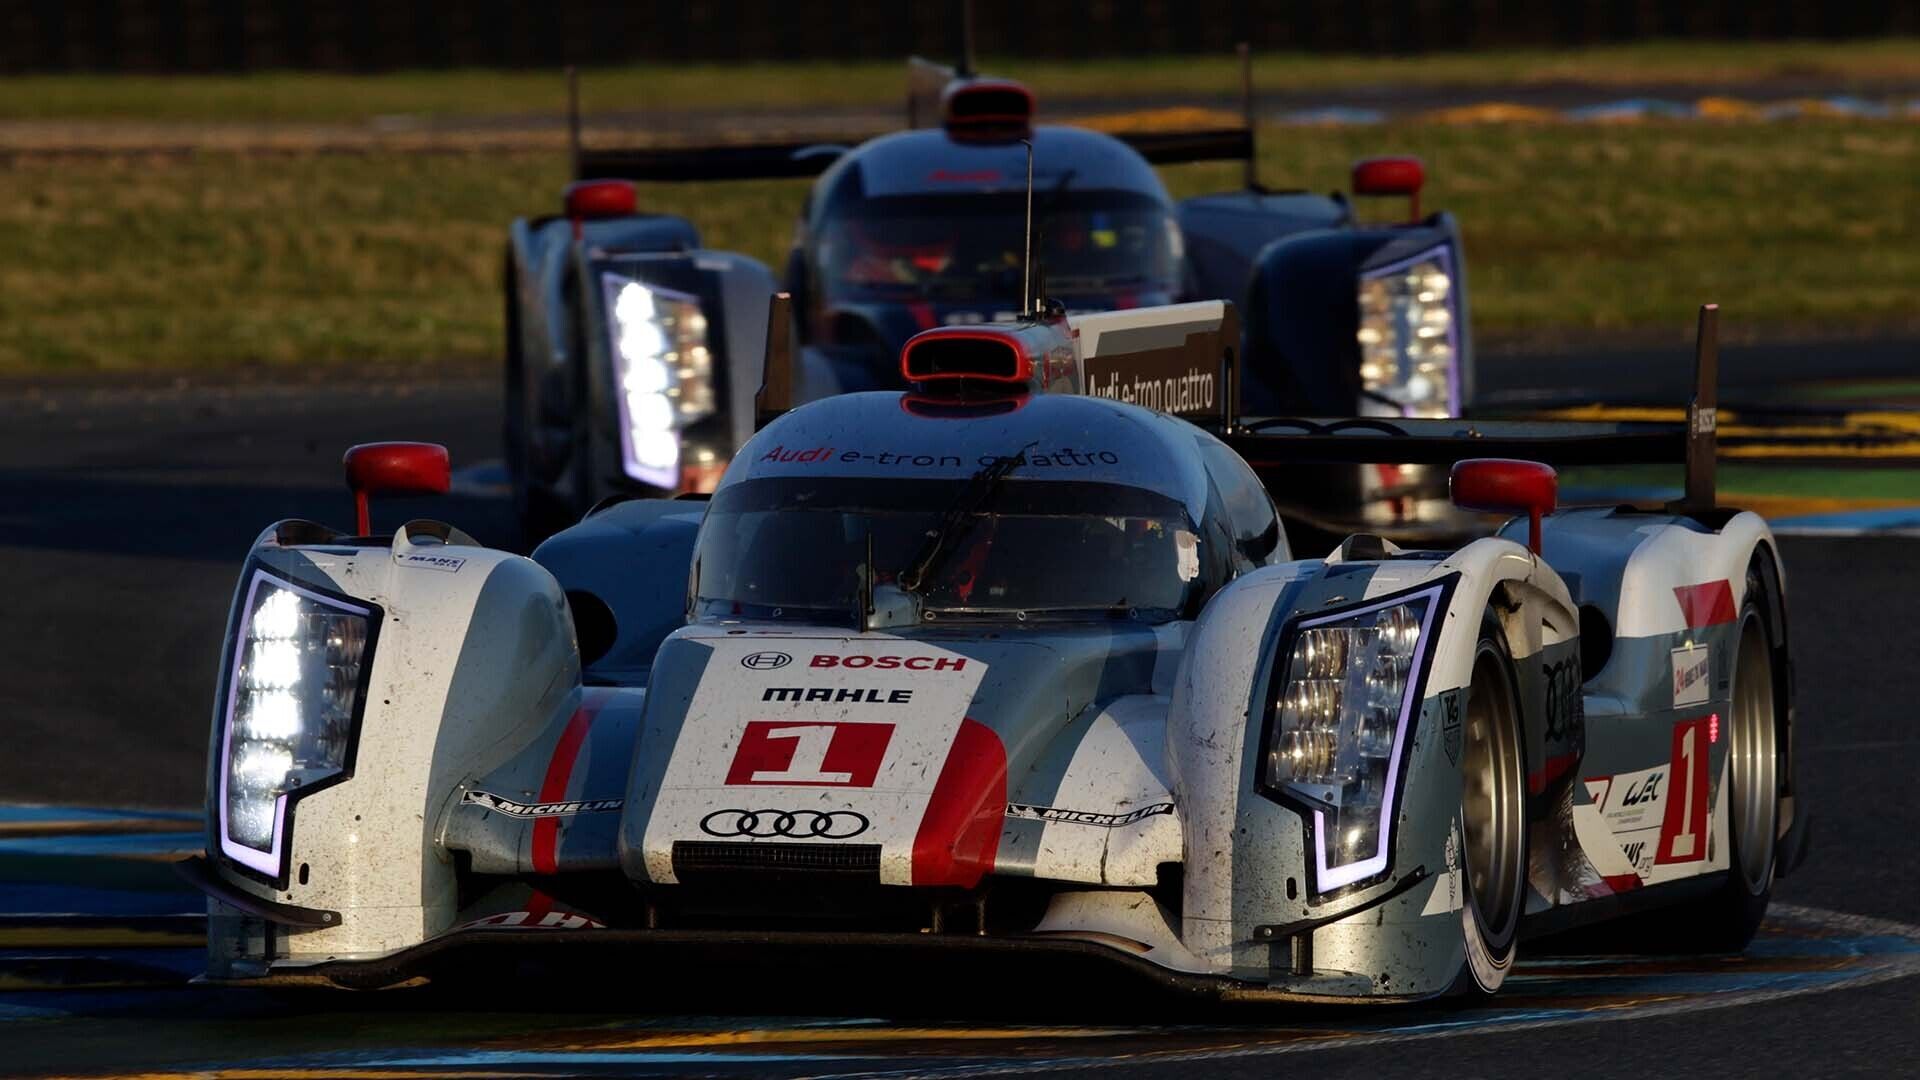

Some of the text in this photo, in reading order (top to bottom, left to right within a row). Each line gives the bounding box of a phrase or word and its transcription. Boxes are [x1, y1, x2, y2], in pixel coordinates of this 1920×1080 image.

[1089, 370, 1119, 400] Adi
[1164, 367, 1213, 415] quattro
[760, 446, 835, 463] Audi
[840, 448, 961, 467] e-tron
[810, 655, 967, 671] BOSCH
[762, 688, 913, 703] MAHLE
[750, 725, 853, 783] 1
[1622, 772, 1664, 806] WEC
[1670, 725, 1696, 857] 1
[497, 801, 625, 815] MICHELIN
[1043, 804, 1171, 825] MICHELIN
